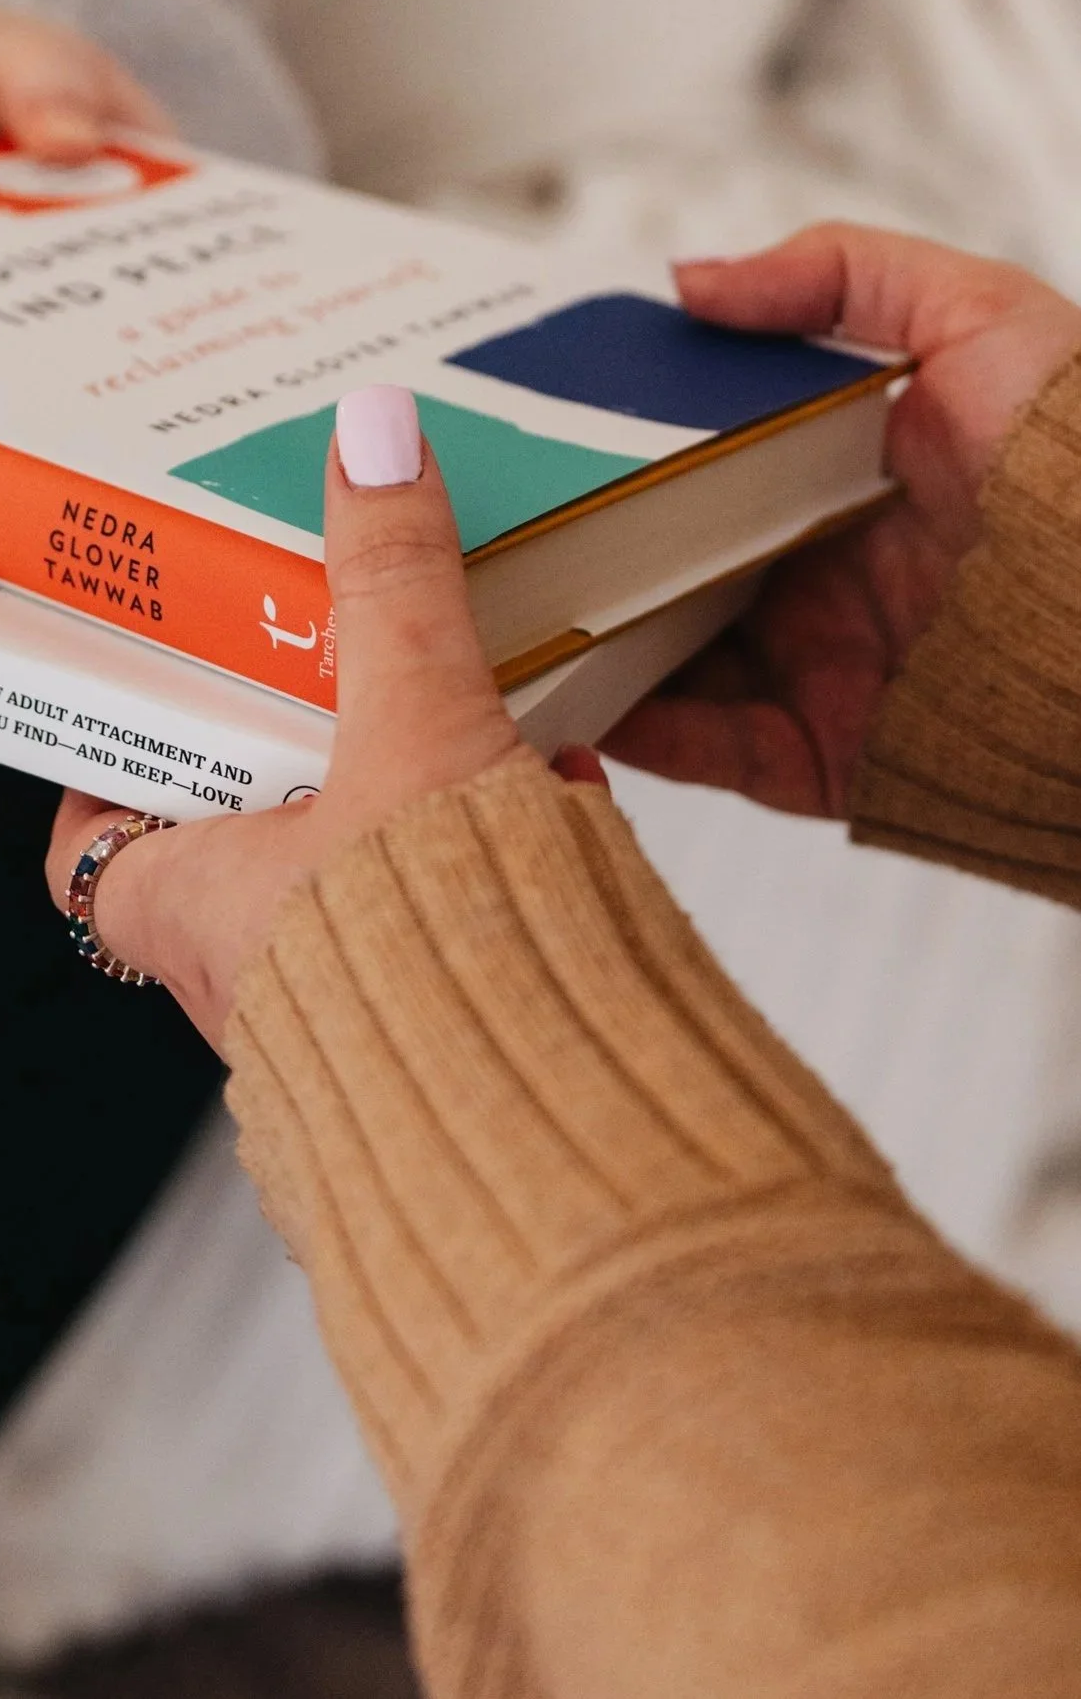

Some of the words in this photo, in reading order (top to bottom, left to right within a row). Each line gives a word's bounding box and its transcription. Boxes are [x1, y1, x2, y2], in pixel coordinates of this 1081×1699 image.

[148, 385, 272, 435] NEDRA
[272, 333, 399, 390] GLOVER
[49, 529, 160, 591] GLOVER
[62, 499, 157, 555] NEDRA
[43, 557, 164, 623] TAWWAB
[6, 691, 68, 723] ADULT
[72, 713, 207, 770] ATTACHMENT
[209, 760, 253, 786] AND
